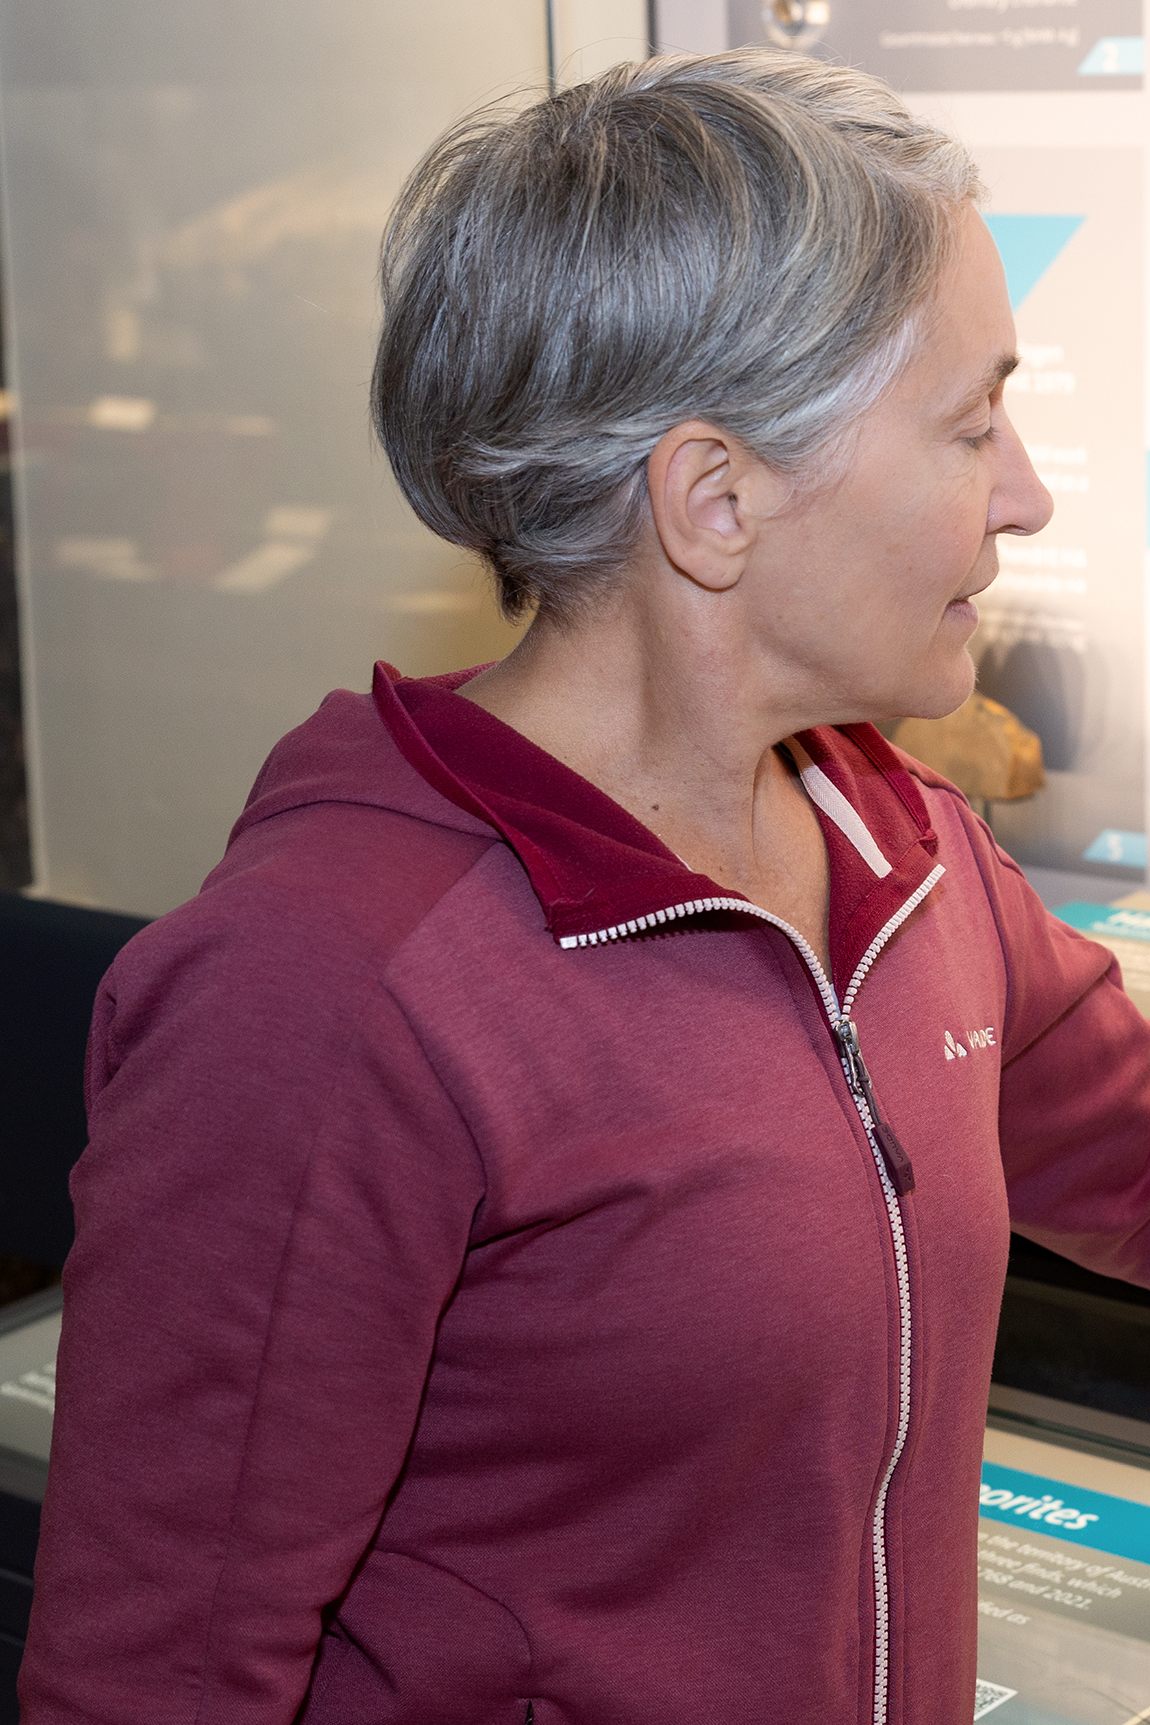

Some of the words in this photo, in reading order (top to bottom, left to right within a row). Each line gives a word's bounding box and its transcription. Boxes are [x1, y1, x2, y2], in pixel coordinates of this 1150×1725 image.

[979, 1484, 1099, 1530] orites
[986, 1534, 1019, 1550] the
[1016, 1544, 1090, 1572] territory
[1085, 1564, 1117, 1579] of
[978, 1565, 1014, 1584] 768
[1008, 1579, 1050, 1596] and
[1066, 1577, 1122, 1600] which
